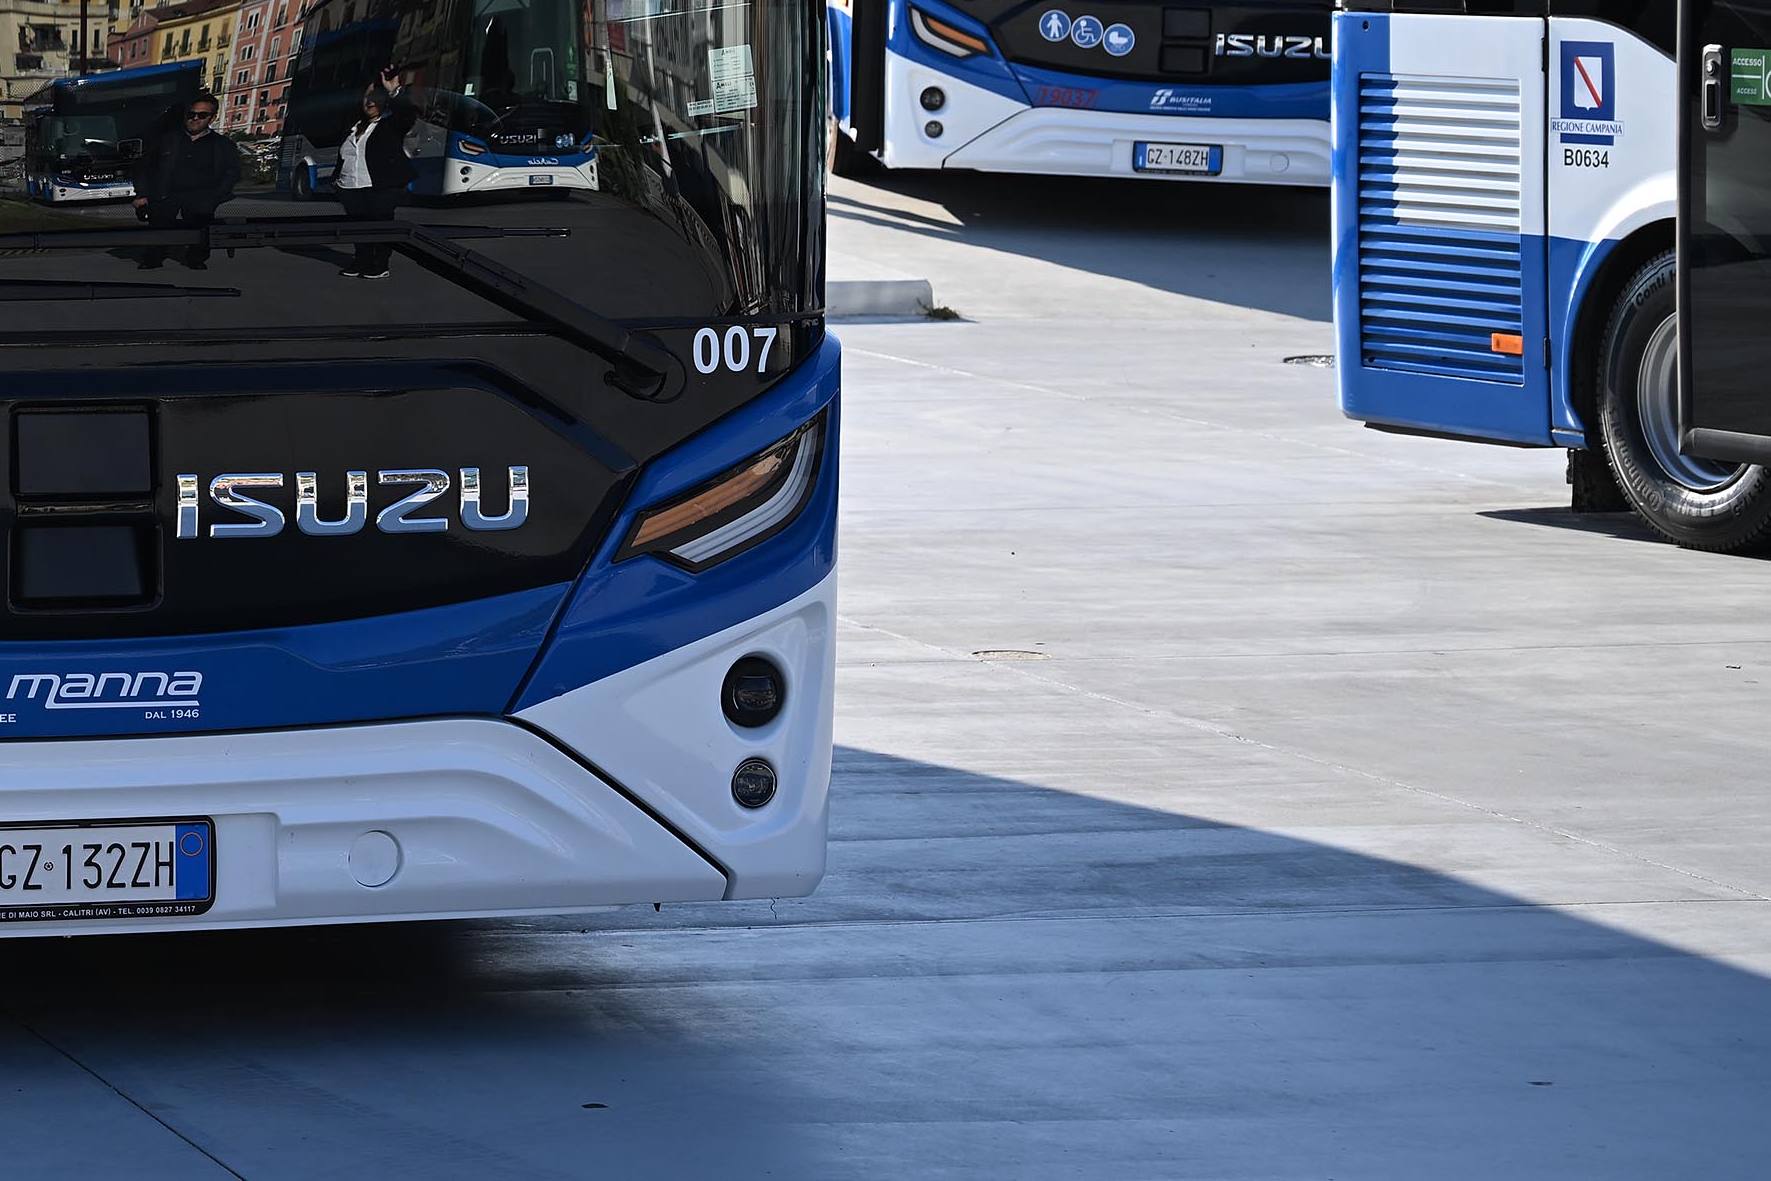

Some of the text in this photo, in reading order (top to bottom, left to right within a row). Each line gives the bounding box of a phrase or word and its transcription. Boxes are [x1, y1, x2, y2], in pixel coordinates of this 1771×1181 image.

[1215, 33, 1331, 59] ISUZU
[1732, 57, 1762, 67] ACCESSO
[1169, 96, 1212, 105] BUSITALIA
[1736, 87, 1757, 95] ACCESS
[1552, 120, 1623, 135] REGIONE CAMPANIA
[1147, 148, 1163, 165] GZ
[1169, 149, 1209, 167] 148ZH
[1564, 148, 1610, 168] B0634
[1635, 272, 1665, 307] Conti
[692, 325, 779, 375] 007
[177, 465, 528, 540] ISUZU
[5, 670, 203, 710] manna
[145, 708, 200, 720] DAL 1946
[62, 840, 175, 890] 132ZH
[8, 911, 17, 919] DI
[40, 910, 57, 918] SRL
[62, 909, 94, 917] CALITRI
[95, 907, 111, 916] (AV)
[118, 907, 135, 915] TEL.
[136, 906, 154, 914] 0039
[155, 905, 173, 913] 0827
[174, 905, 196, 913] 34117
